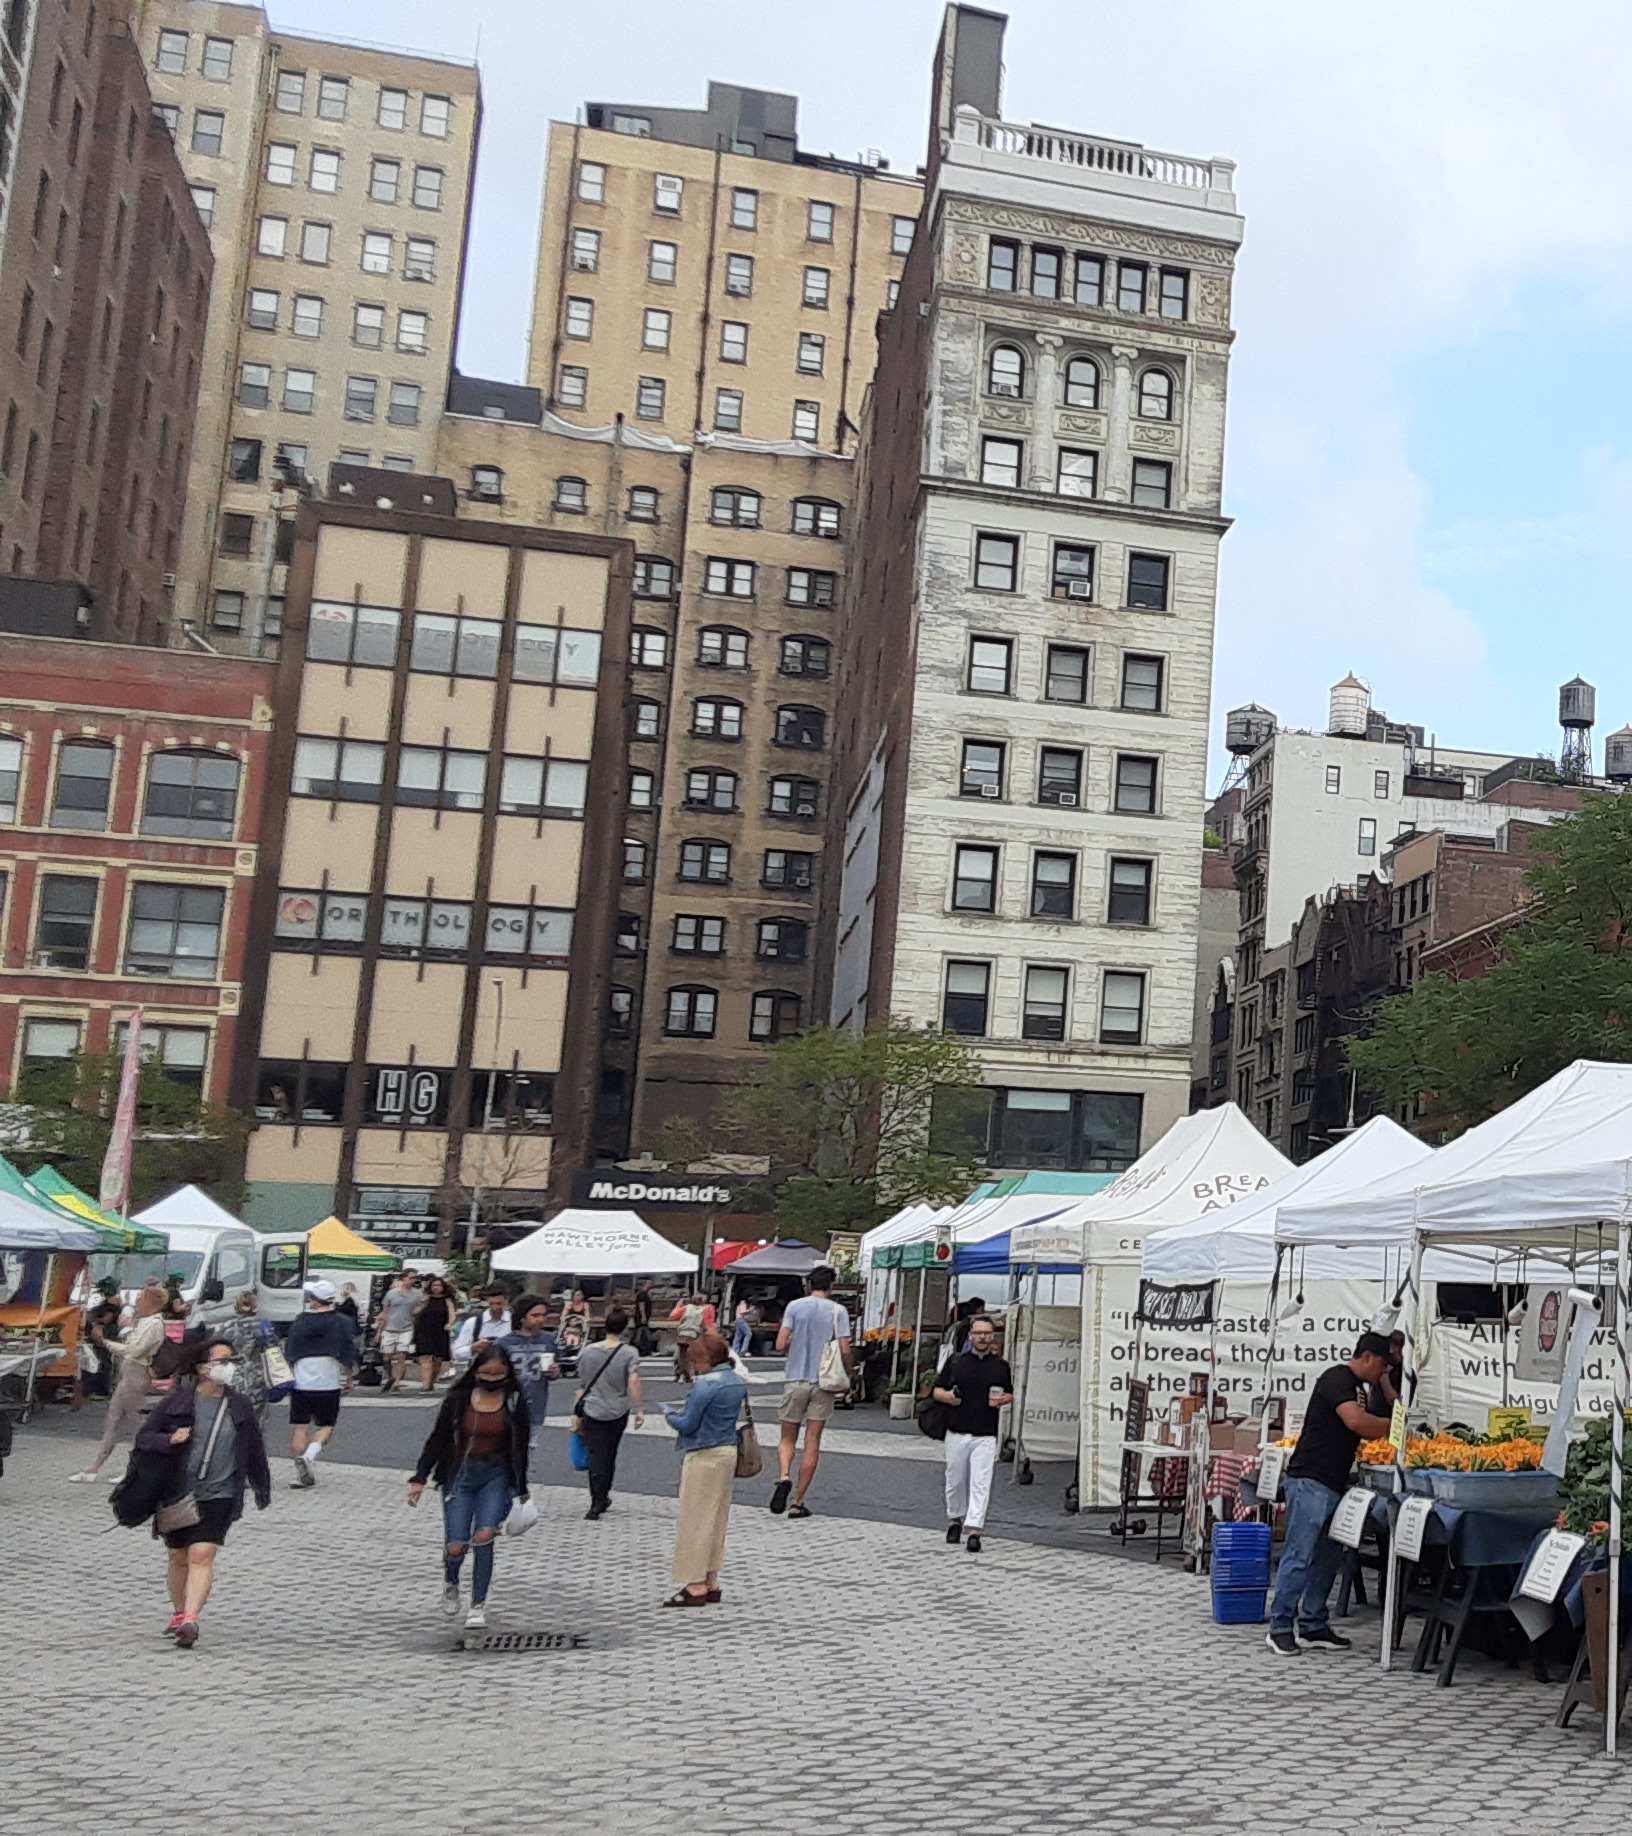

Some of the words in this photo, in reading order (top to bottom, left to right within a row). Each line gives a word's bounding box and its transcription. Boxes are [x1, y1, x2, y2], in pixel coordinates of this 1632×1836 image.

[327, 906, 551, 935] ORTHOLOGY
[376, 1069, 440, 1115] HG
[588, 1182, 732, 1203] McDonald's
[544, 1231, 650, 1243] HAWTHORNE
[544, 1238, 603, 1249] VALLEY
[603, 1241, 642, 1253] farm
[1302, 1317, 1315, 1332] a
[1324, 1316, 1372, 1334] crus
[1111, 1341, 1137, 1361] of
[1231, 1343, 1285, 1363] thou
[1293, 1344, 1352, 1362] taste
[1109, 1371, 1131, 1391] al
[1146, 1371, 1186, 1392] the
